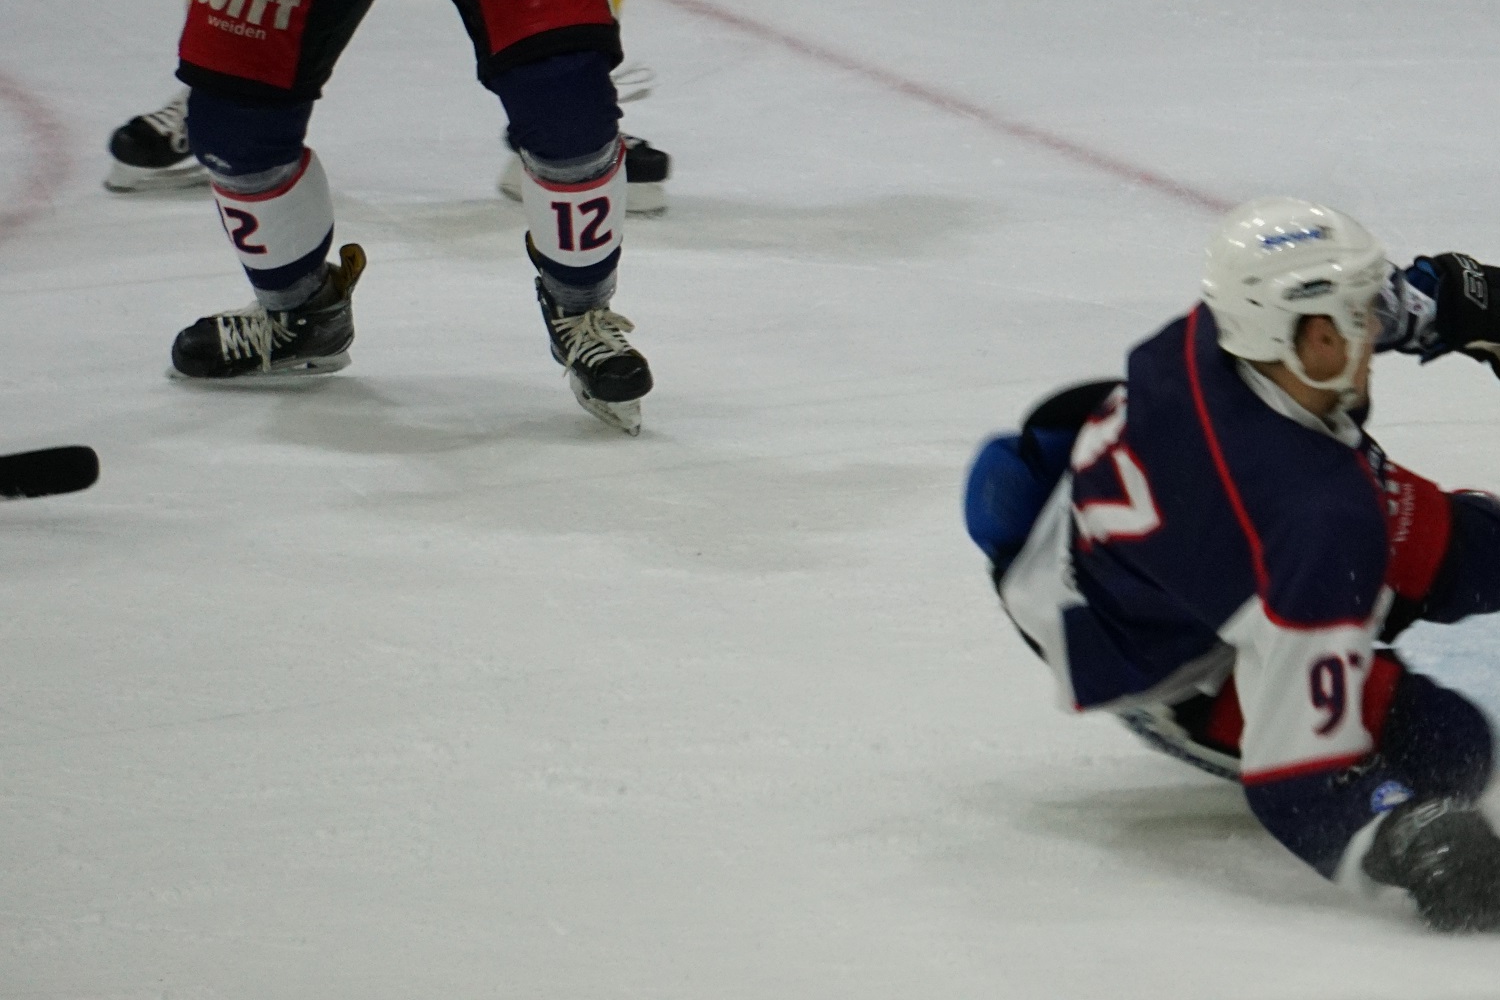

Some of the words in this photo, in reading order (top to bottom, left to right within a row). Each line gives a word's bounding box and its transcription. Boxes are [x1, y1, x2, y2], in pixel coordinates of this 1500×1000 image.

[207, 14, 267, 40] weiden
[216, 199, 268, 255] 2
[551, 196, 614, 253] 12
[1311, 652, 1362, 737] 9
